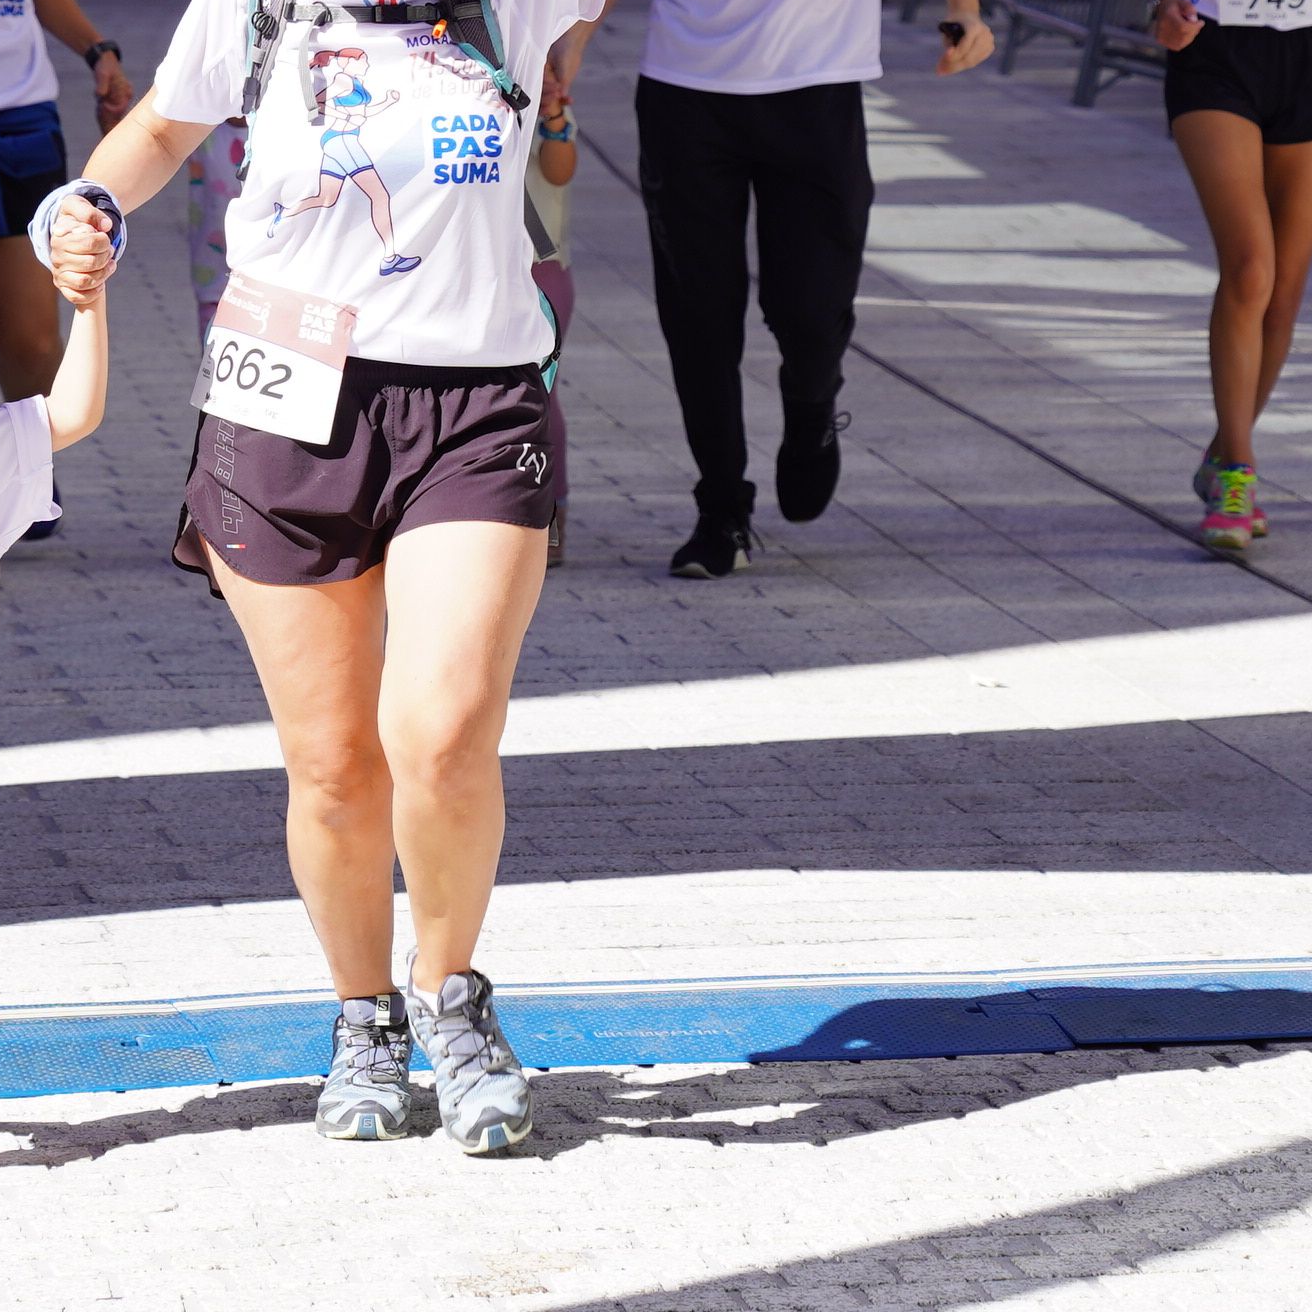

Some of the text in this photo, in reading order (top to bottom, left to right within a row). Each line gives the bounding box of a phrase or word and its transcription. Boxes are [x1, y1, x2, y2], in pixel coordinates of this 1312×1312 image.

[430, 114, 501, 134] CADA
[432, 134, 503, 159] PAS
[433, 162, 501, 185] SUMA
[215, 340, 292, 400] 662
